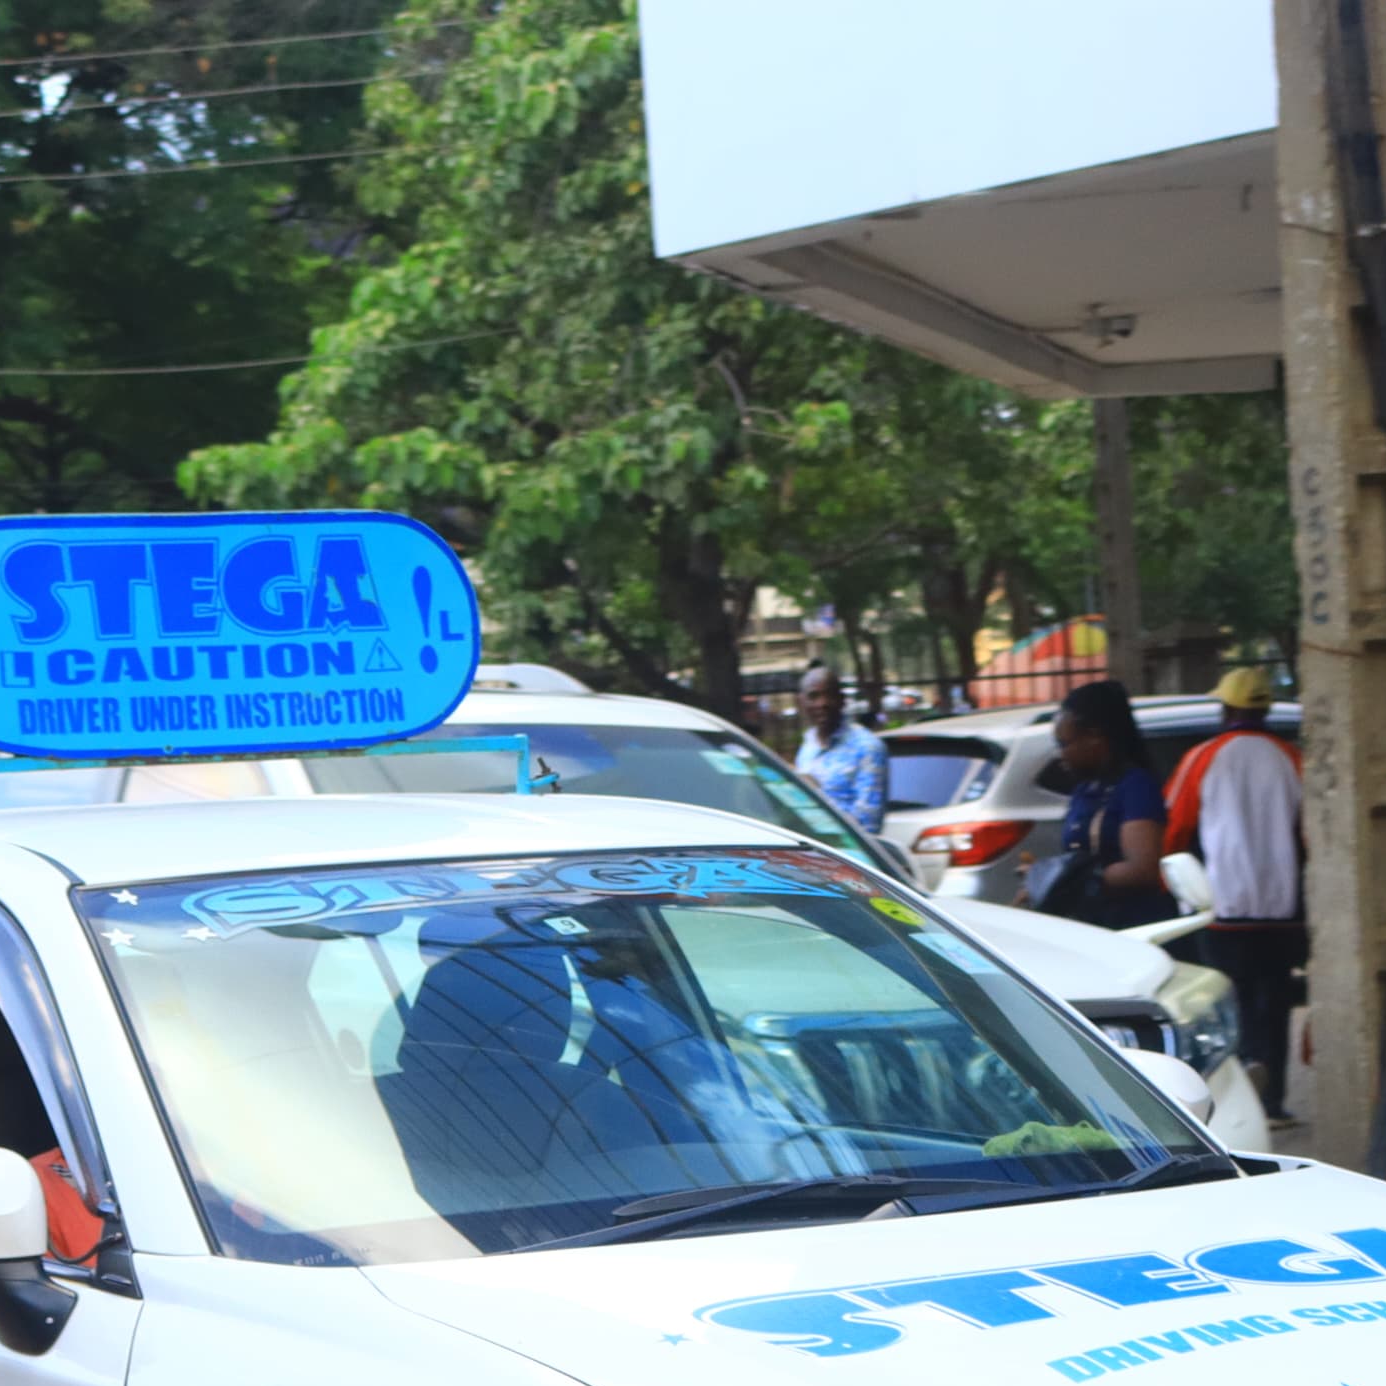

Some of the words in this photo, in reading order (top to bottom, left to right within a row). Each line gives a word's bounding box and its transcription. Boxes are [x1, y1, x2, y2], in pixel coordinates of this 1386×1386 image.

[0, 534, 389, 645] STEGA
[441, 610, 464, 641] L
[46, 641, 356, 686] CAUTION
[18, 697, 120, 735] DRIVER
[129, 693, 218, 733] UNDER
[224, 687, 405, 730] INSTRUCTION
[1045, 1314, 1300, 1383] DRIVING
